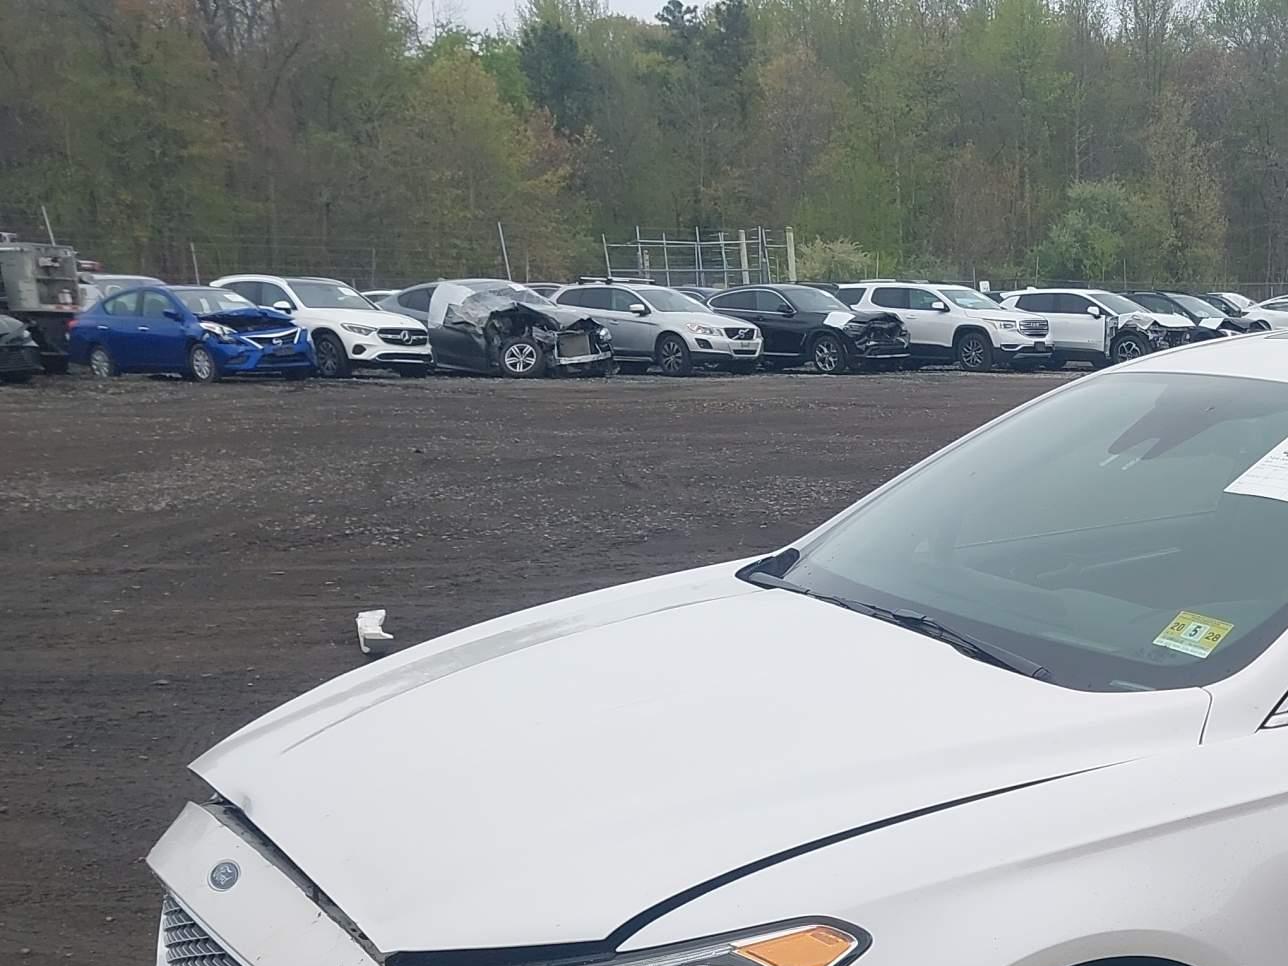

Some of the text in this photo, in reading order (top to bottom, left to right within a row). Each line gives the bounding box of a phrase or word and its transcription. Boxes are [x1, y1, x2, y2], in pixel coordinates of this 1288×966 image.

[1170, 622, 1222, 642] 20 5 28
